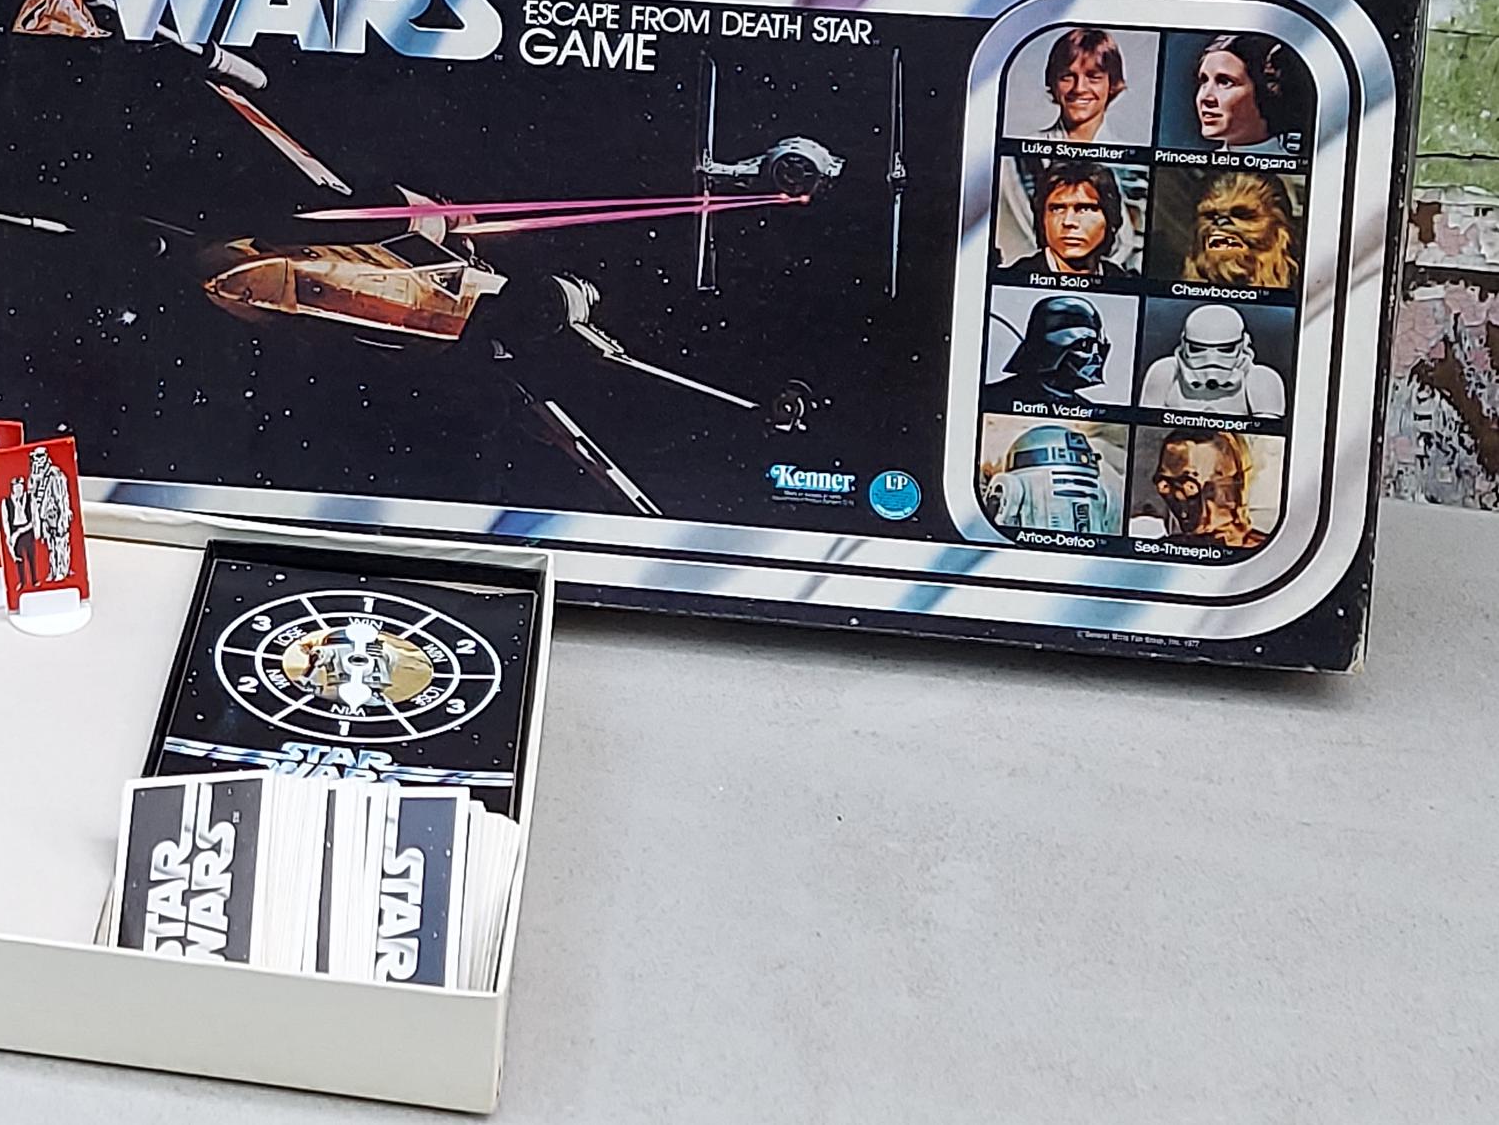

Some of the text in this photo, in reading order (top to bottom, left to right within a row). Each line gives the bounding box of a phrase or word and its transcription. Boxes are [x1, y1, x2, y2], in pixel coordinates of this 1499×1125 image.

[523, 0, 874, 45] ESCAPE FROM DEATH STAR
[518, 27, 657, 72] GAME
[1021, 140, 1124, 160] Luke Skywalker
[1155, 150, 1298, 172] Princess Leia Organa
[1029, 273, 1090, 288] Han Solo
[1171, 283, 1258, 300] Chewbacca
[1012, 400, 1094, 418] Darth Vader
[1162, 412, 1251, 431] Stormtrooper
[769, 464, 856, 493] Kenner
[1016, 530, 1097, 549] Artoo-Detoo
[1133, 540, 1222, 560] See-Threepio
[363, 597, 377, 613] 1
[251, 615, 272, 631] 3
[348, 616, 384, 632] WIN
[273, 625, 307, 647] LOSE
[421, 642, 449, 665] WIN
[456, 639, 477, 655] 2
[237, 676, 259, 694] 2
[265, 668, 292, 690] WIN
[412, 685, 446, 707] LOSE
[330, 703, 367, 717] WIN
[445, 698, 466, 715] 3
[338, 720, 350, 737] 1
[280, 741, 393, 768] STAR
[376, 847, 426, 981] STAR
